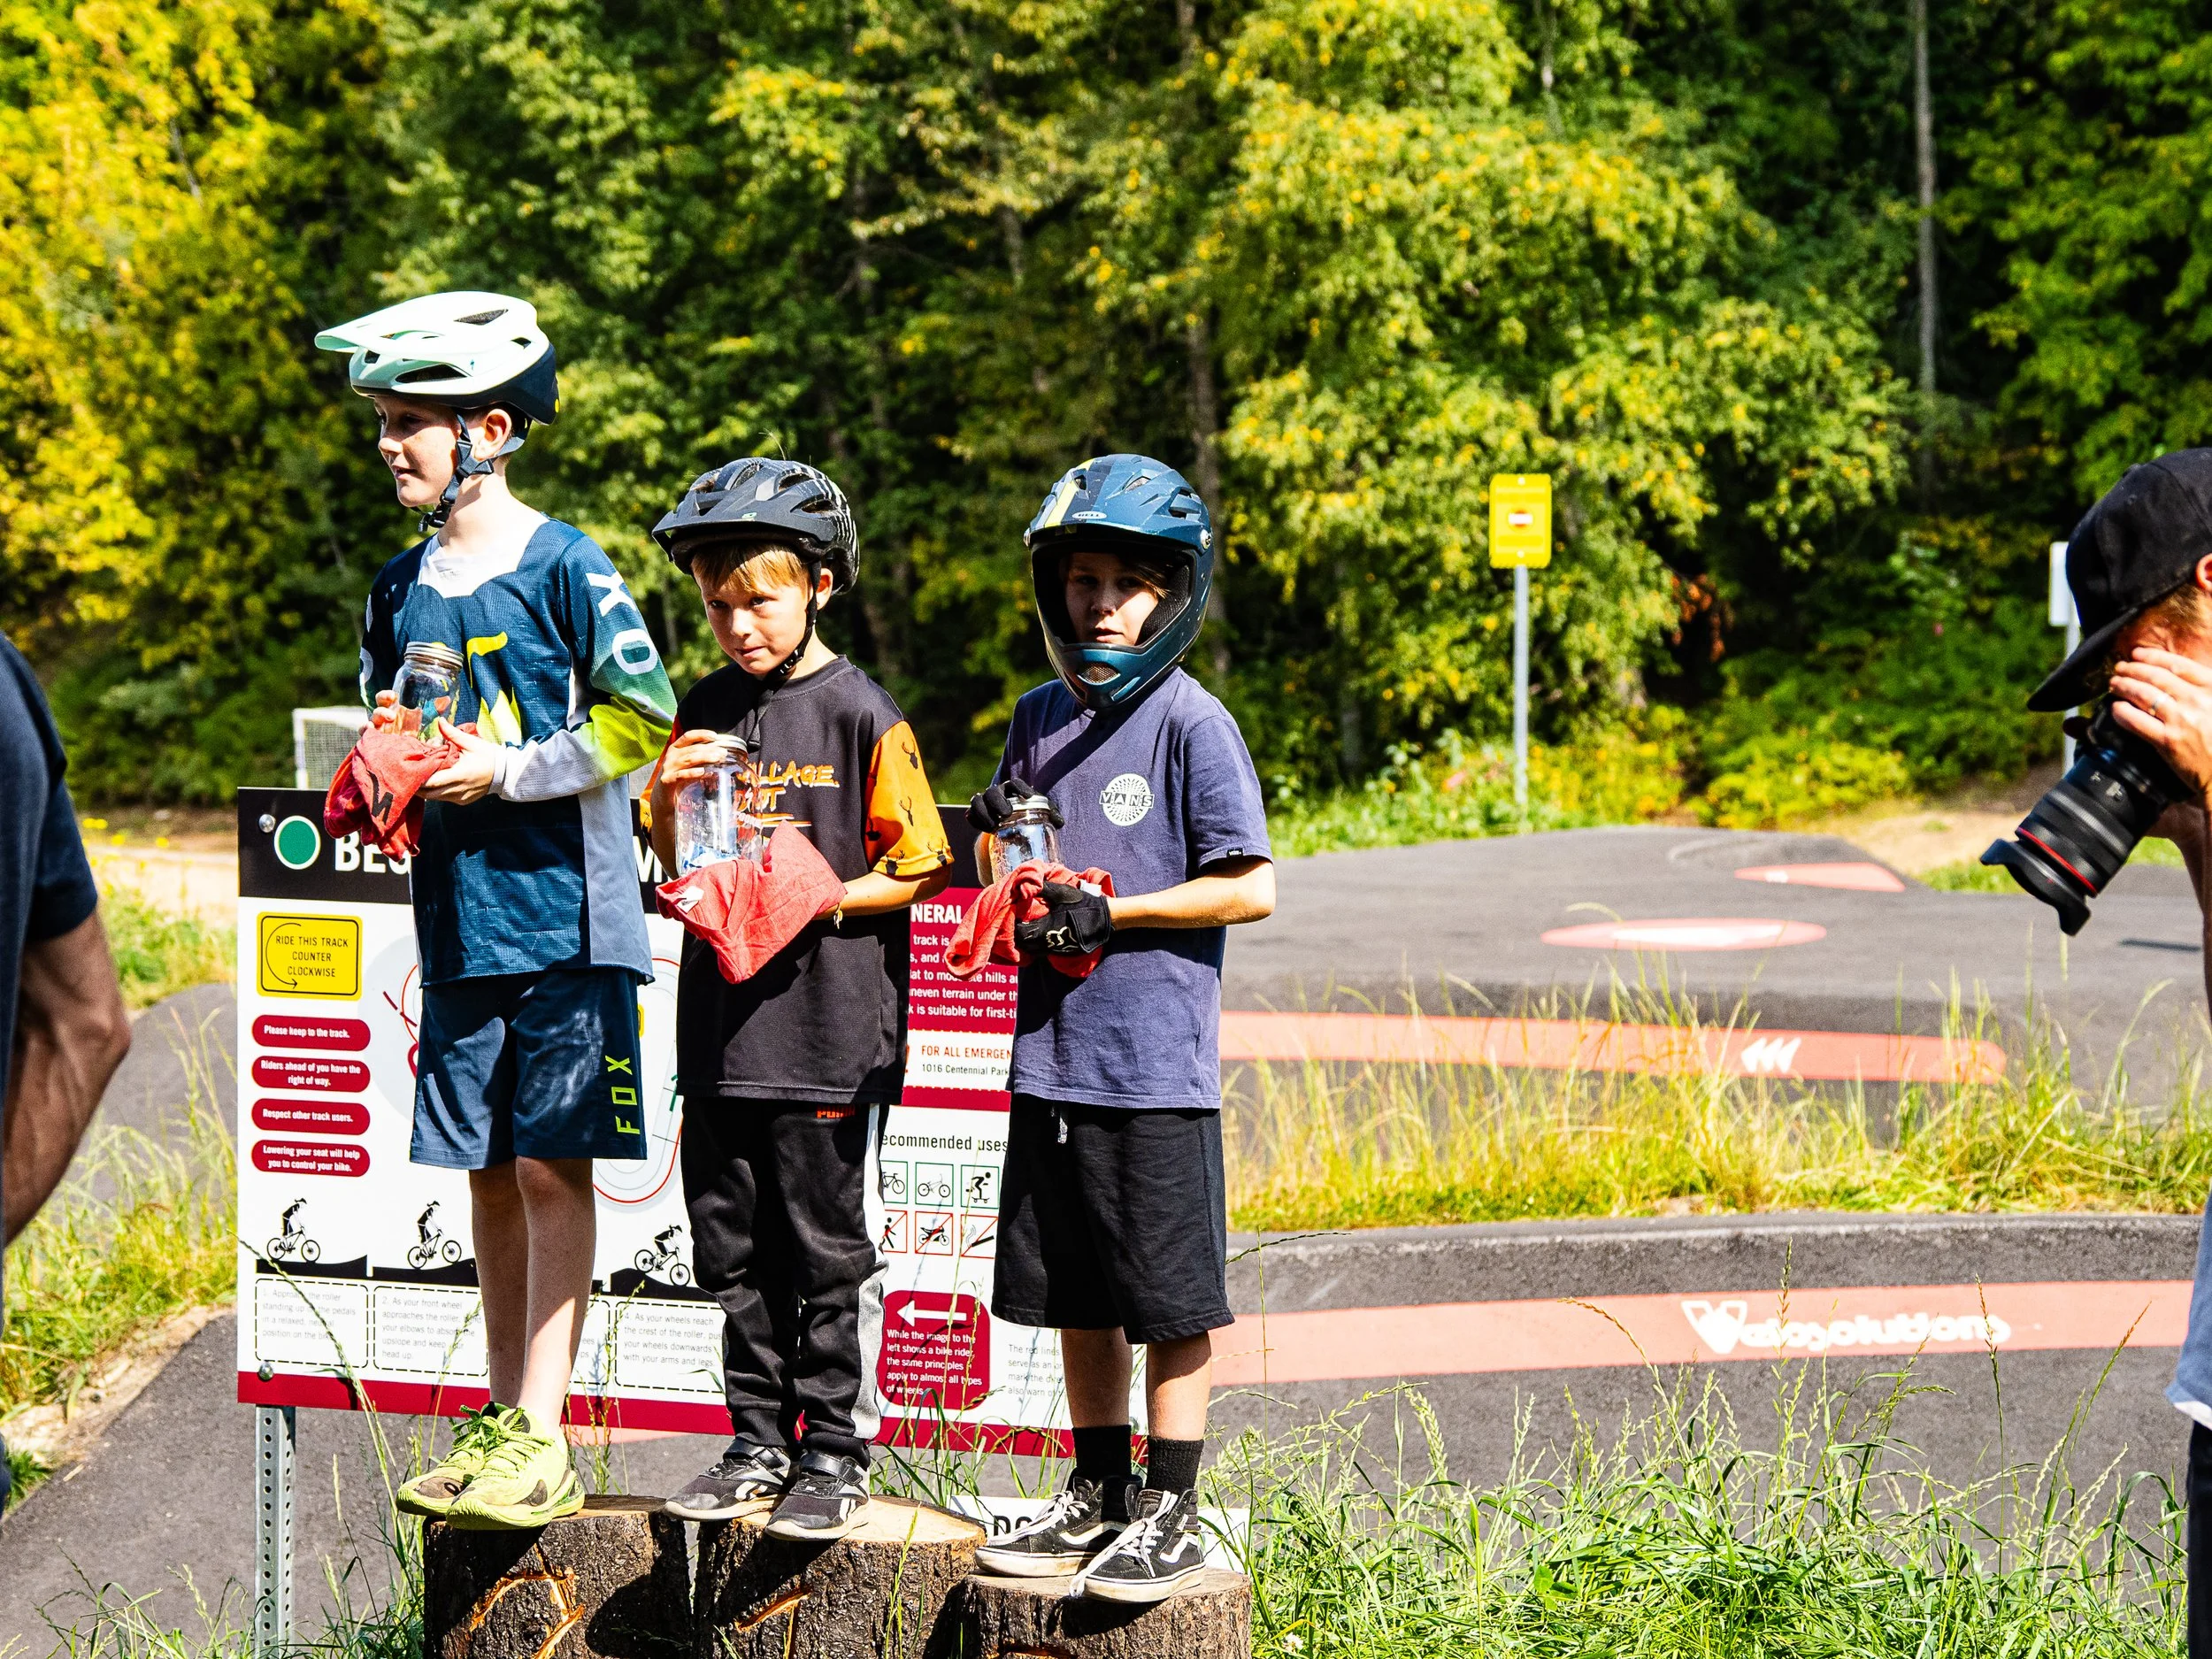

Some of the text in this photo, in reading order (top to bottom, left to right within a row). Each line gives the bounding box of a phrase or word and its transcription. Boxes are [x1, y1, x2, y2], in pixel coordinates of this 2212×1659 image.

[1100, 791, 1154, 807] VANS
[910, 903, 963, 924] NERAL
[275, 935, 349, 948] RIDE THIS TRACK
[913, 933, 950, 946] track is
[292, 951, 332, 962] COUNTER
[920, 952, 940, 963] and
[288, 965, 336, 978] CLOCKWISE
[924, 970, 933, 980] to
[985, 972, 1007, 984] hills
[942, 987, 974, 1000] terrain
[977, 989, 1006, 1001] under
[917, 1003, 926, 1015] is
[927, 1004, 967, 1017] suitable
[970, 1006, 984, 1018] for
[264, 1025, 350, 1038] Please keep to the track.
[921, 1045, 940, 1056] FOR
[944, 1047, 961, 1057] ALL
[261, 1060, 361, 1074] Riders ahead of you have the
[922, 1064, 943, 1073] 1016
[945, 1064, 988, 1075] Centennial
[288, 1075, 331, 1087] right of way.
[605, 1055, 641, 1135] FOX
[263, 1109, 291, 1119] Respect
[292, 1110, 311, 1119] other
[311, 1111, 331, 1121] track
[882, 1134, 972, 1150] ecommended
[263, 1144, 360, 1160] Lowering your seat will help
[267, 1160, 280, 1169] you
[290, 1161, 316, 1170] control
[317, 1163, 333, 1171] your
[334, 1162, 352, 1171] bike.
[635, 1312, 644, 1322] As
[646, 1315, 663, 1324] your
[664, 1315, 691, 1325] wheels
[692, 1317, 714, 1326] reach
[638, 1327, 657, 1336] crest
[669, 1329, 682, 1338] the
[887, 1329, 910, 1340] While
[910, 1331, 925, 1340] the
[952, 1333, 961, 1342] to
[624, 1340, 712, 1353] your wheels downwards
[887, 1343, 901, 1353] left
[902, 1344, 926, 1355] shows
[935, 1346, 953, 1356] bike
[954, 1348, 972, 1357] ride
[1009, 1344, 1023, 1353] The
[623, 1354, 640, 1363] with
[641, 1356, 658, 1364] your
[660, 1356, 680, 1365] arms
[681, 1357, 696, 1366] and
[887, 1357, 964, 1371] the same princples
[887, 1371, 909, 1382] apply
[910, 1372, 918, 1381] to
[920, 1373, 945, 1383] almos
[949, 1375, 958, 1384] all
[886, 1384, 895, 1394] of
